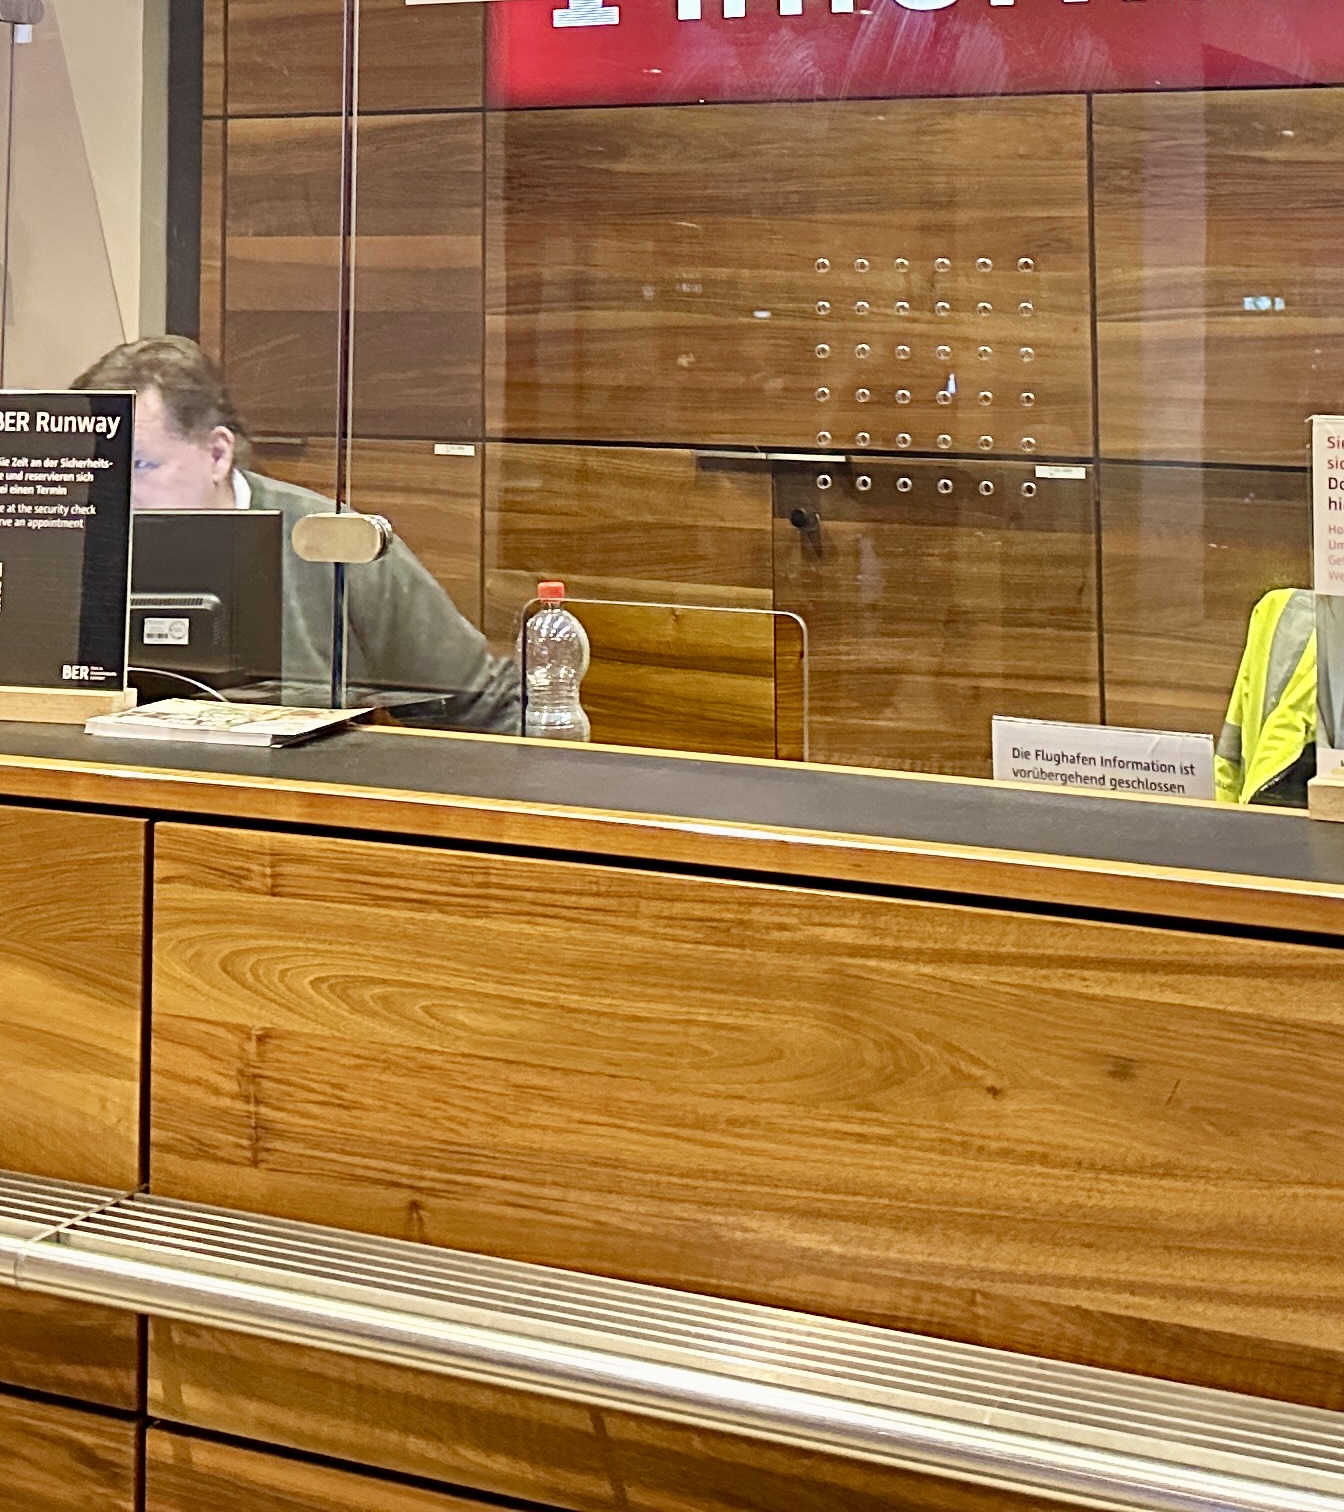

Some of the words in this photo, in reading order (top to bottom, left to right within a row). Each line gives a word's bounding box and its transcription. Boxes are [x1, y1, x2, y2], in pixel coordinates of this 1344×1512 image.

[36, 411, 121, 439] Runway
[11, 457, 28, 467] Zeit
[30, 459, 42, 467] an
[43, 458, 58, 468] der
[60, 458, 113, 469] Sicherheits-
[6, 471, 23, 481] und
[24, 472, 74, 482] reservieren
[76, 472, 94, 482] sich
[9, 485, 34, 494] einen
[36, 486, 67, 495] Termin
[7, 504, 15, 513] at
[17, 504, 32, 513] the
[34, 505, 69, 516] security
[71, 505, 96, 515] check
[14, 519, 26, 527] an
[27, 518, 84, 529] appointment
[62, 665, 89, 680] BER
[1011, 747, 1031, 760] Die
[1035, 749, 1097, 766] Flughafen
[1100, 755, 1176, 774] Information
[1179, 761, 1195, 776] ist
[1011, 767, 1106, 786] vorübergehend
[1109, 776, 1185, 794] geschlossen
